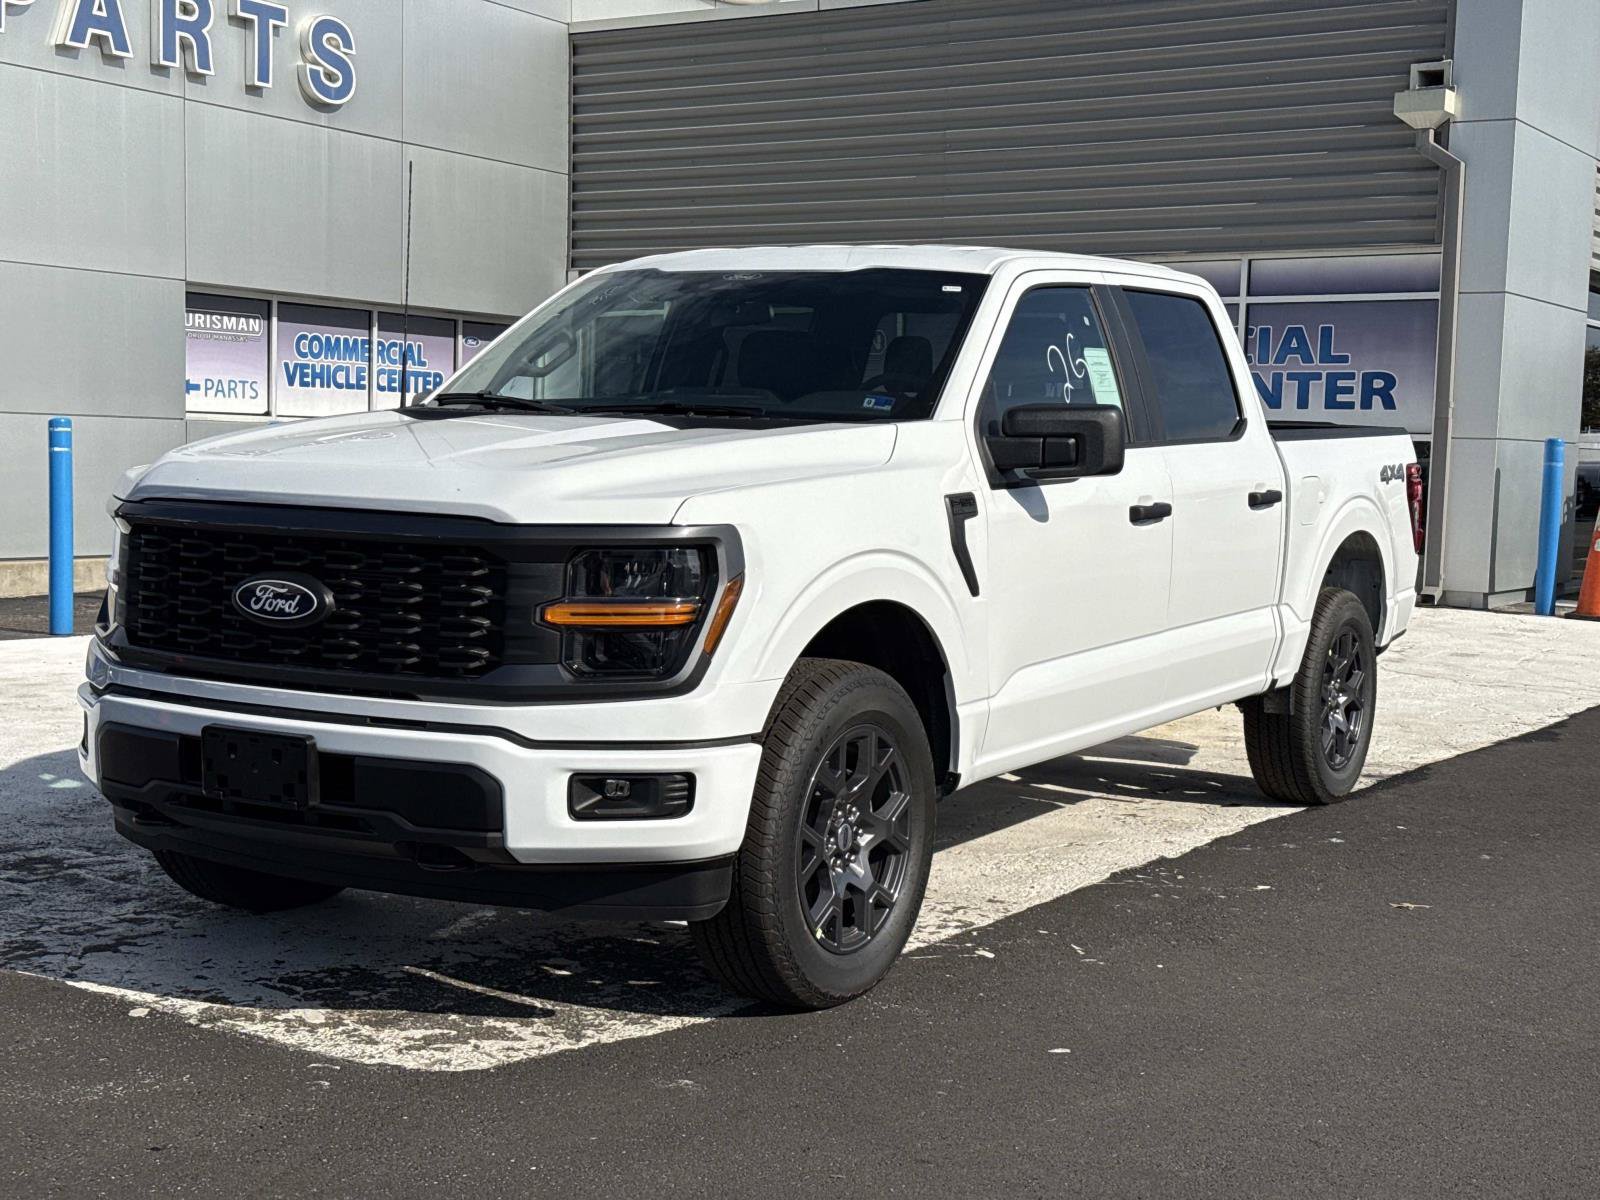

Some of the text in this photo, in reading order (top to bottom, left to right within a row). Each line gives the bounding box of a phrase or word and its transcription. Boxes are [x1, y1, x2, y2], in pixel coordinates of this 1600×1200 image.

[294, 332, 428, 368] COMMERCIAL
[204, 378, 259, 399] PARTS
[283, 361, 367, 391] VEHICLE
[248, 583, 302, 614] Ford
